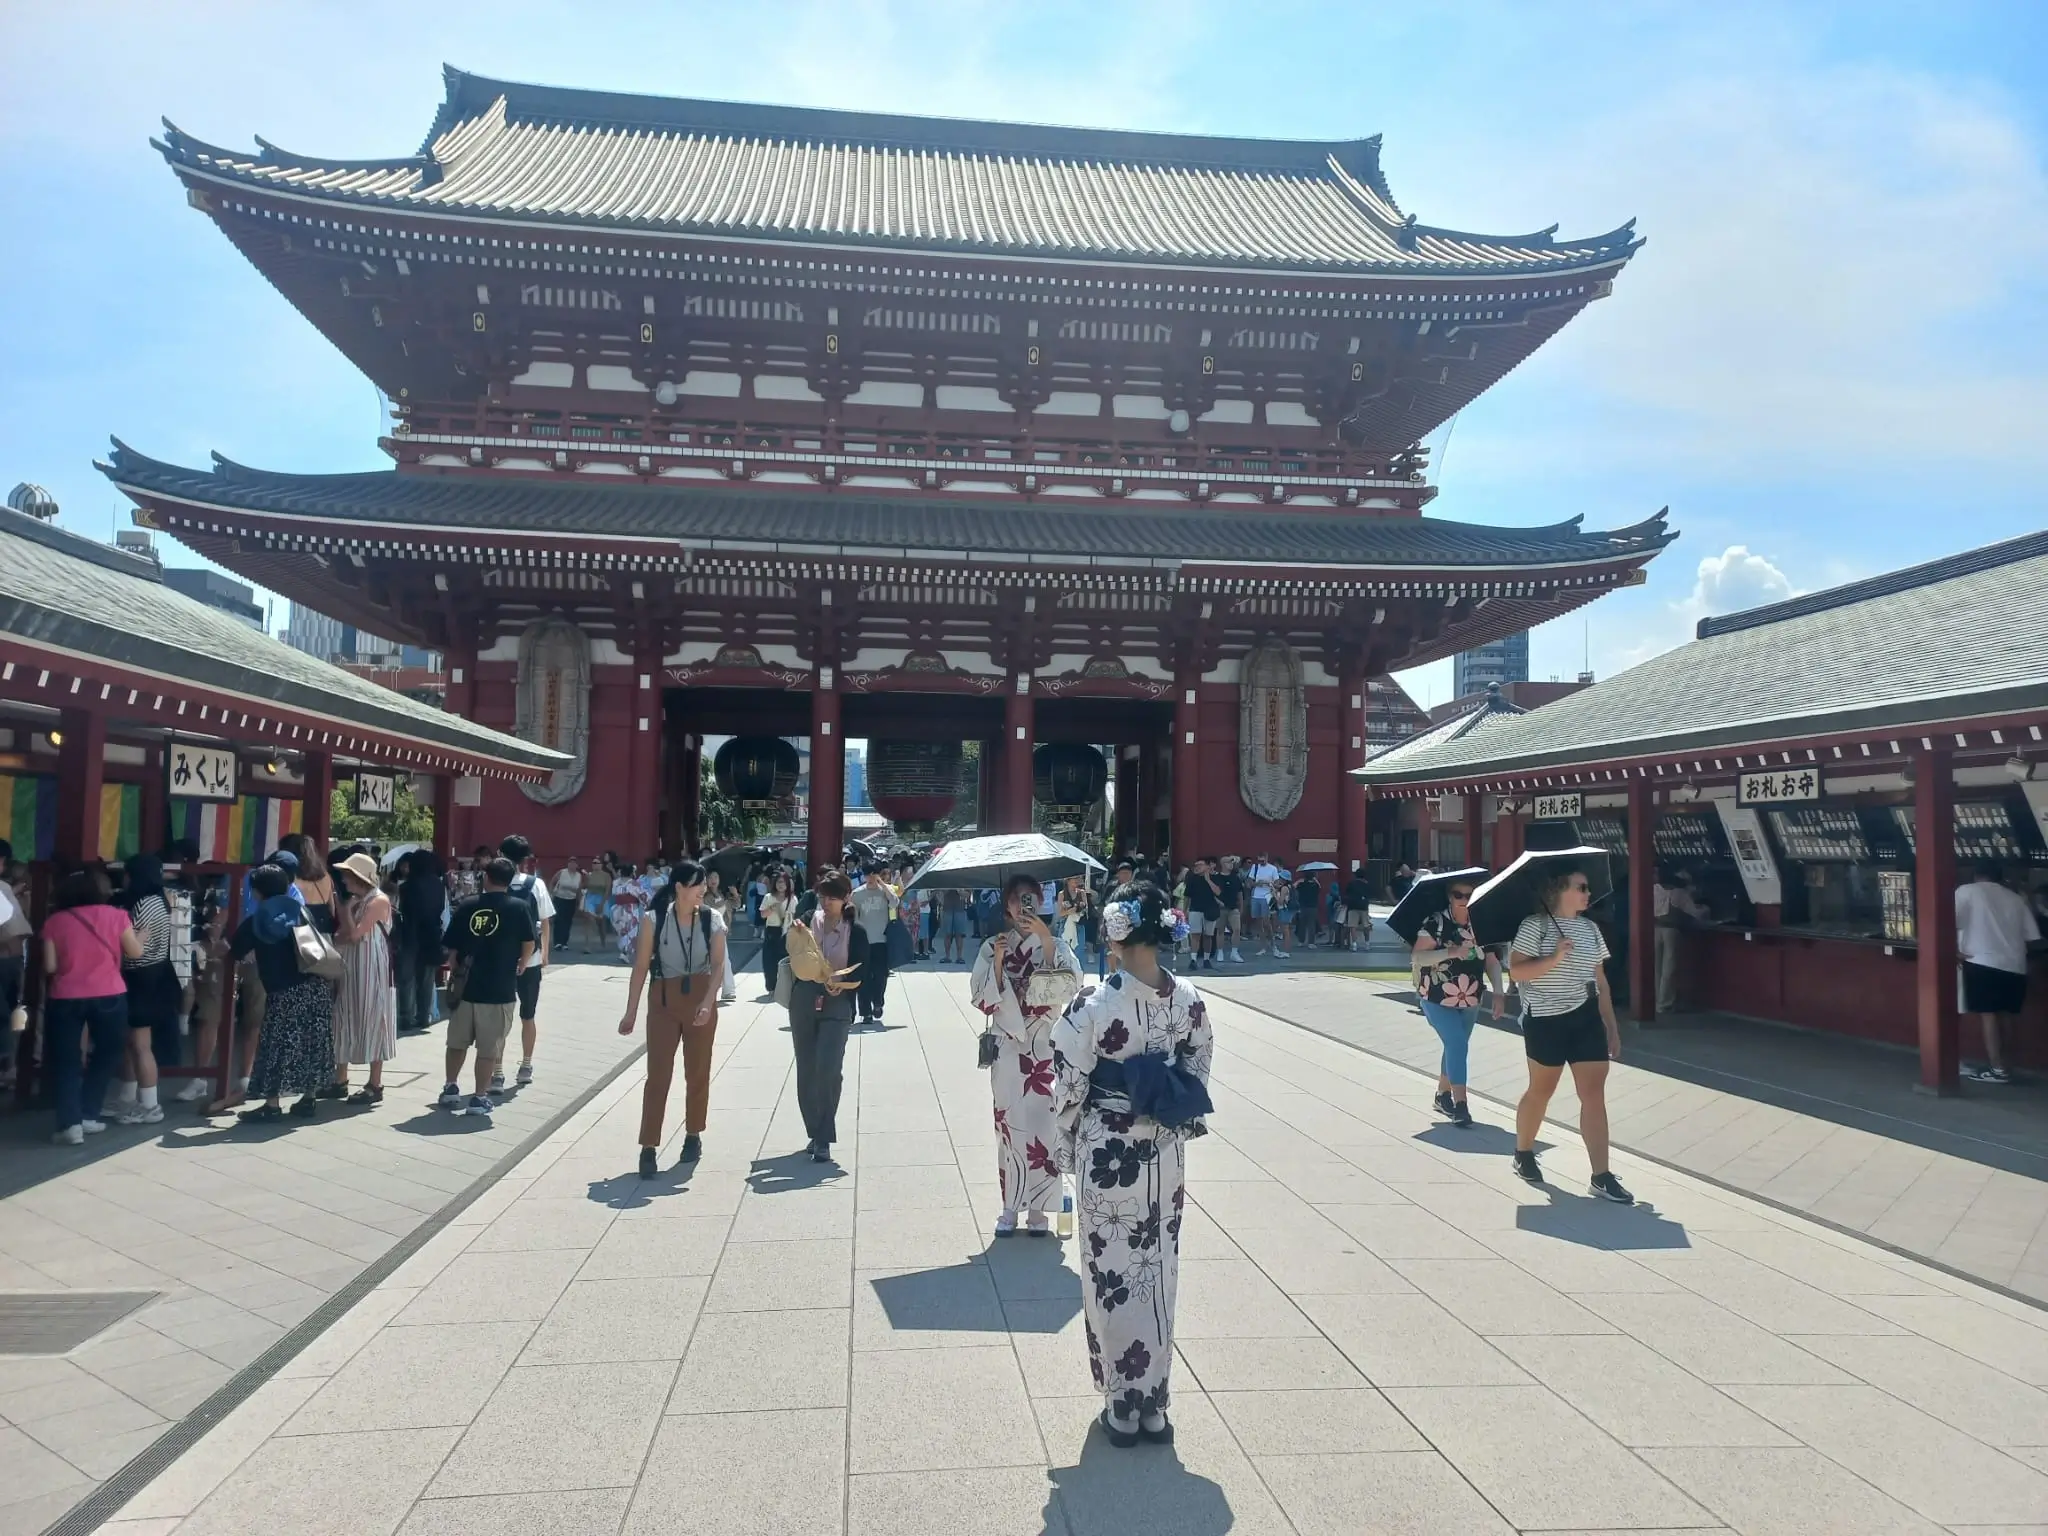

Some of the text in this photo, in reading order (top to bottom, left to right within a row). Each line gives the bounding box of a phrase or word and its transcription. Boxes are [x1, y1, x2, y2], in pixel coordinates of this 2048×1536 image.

[174, 752, 228, 788] みくじ
[361, 779, 389, 807] みくじ
[1746, 771, 1815, 799] お札お守
[1539, 795, 1580, 817] お札お守
